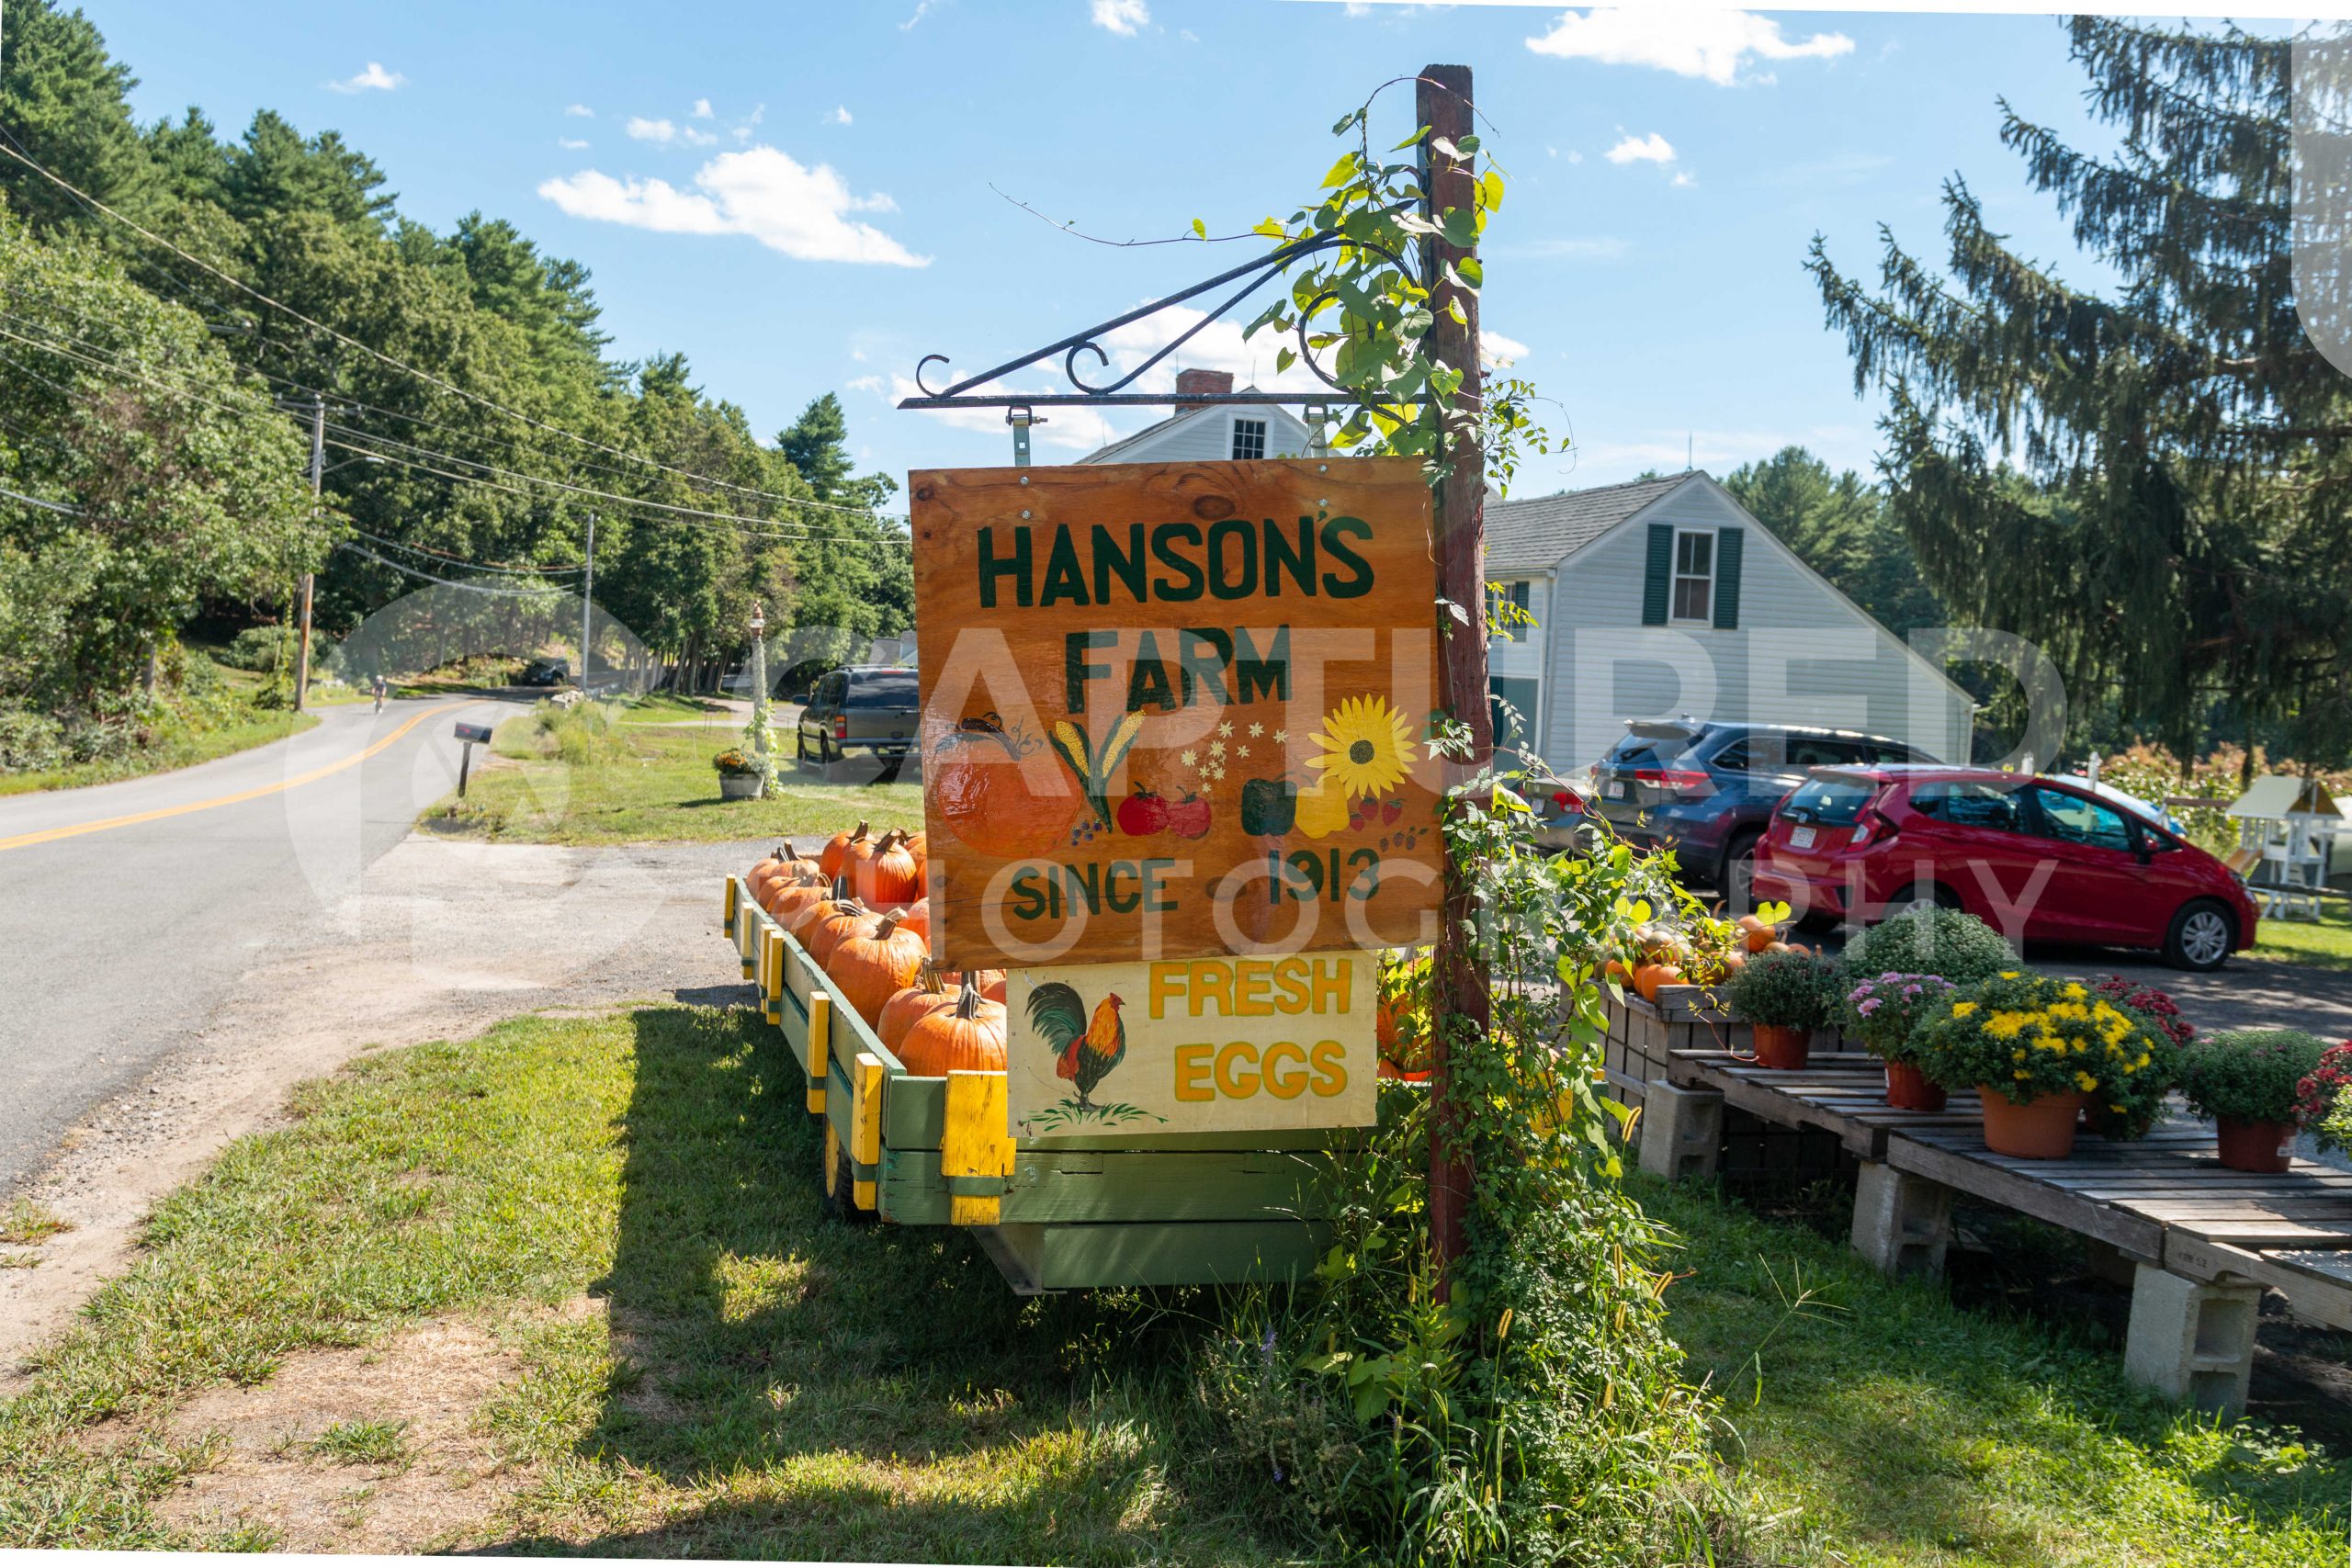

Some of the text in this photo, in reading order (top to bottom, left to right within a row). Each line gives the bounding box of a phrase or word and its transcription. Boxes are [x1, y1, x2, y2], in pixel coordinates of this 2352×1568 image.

[977, 510, 1374, 608] HANSON'S
[1064, 624, 1293, 715] FARM
[1011, 847, 1380, 920] SINCE 1913
[1148, 958, 1353, 1020] FRESH
[1174, 1040, 1349, 1103] EGGS
